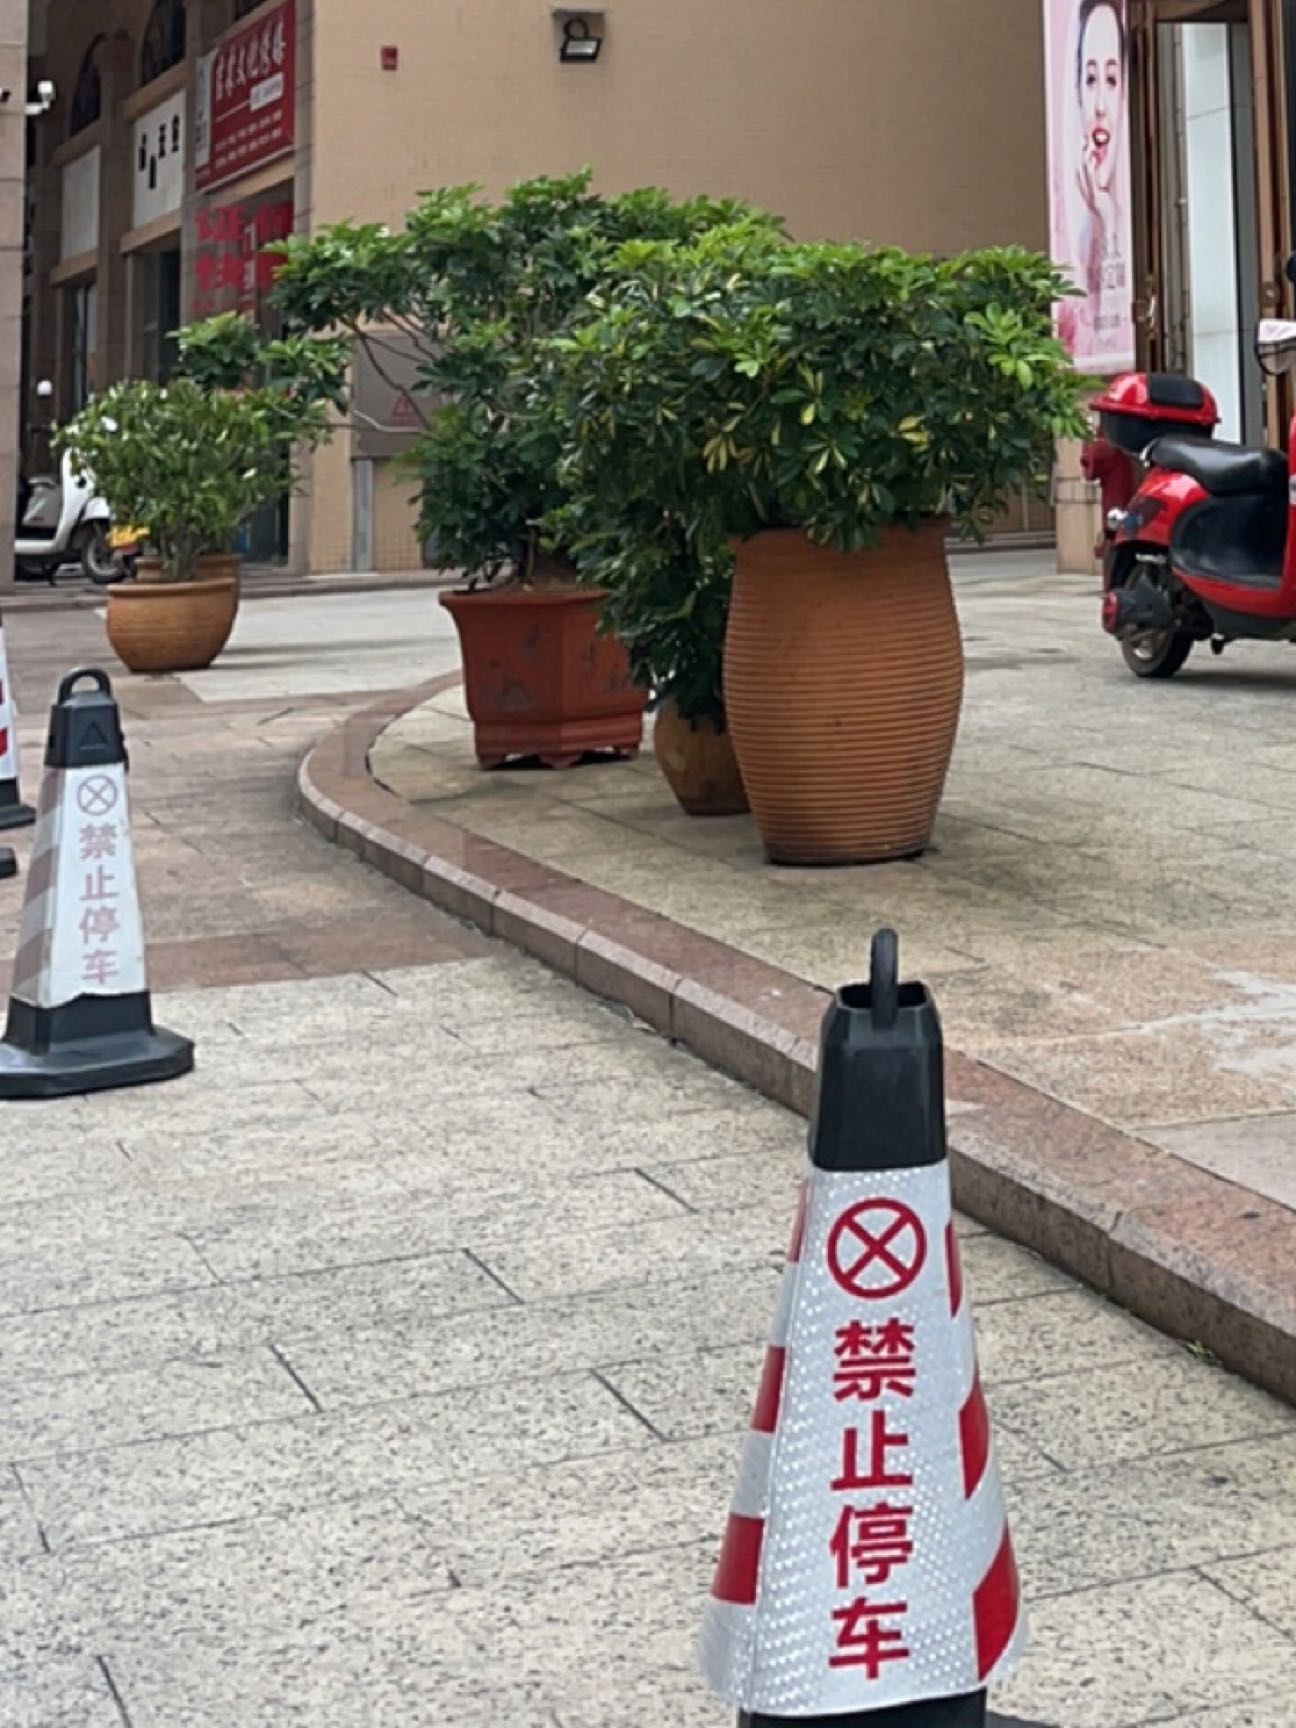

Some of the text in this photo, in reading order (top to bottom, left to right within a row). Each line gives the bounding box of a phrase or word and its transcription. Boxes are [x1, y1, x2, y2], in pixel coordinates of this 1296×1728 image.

[78, 823, 120, 986] 禁止停车
[828, 1319, 917, 1680] 禁止停车
